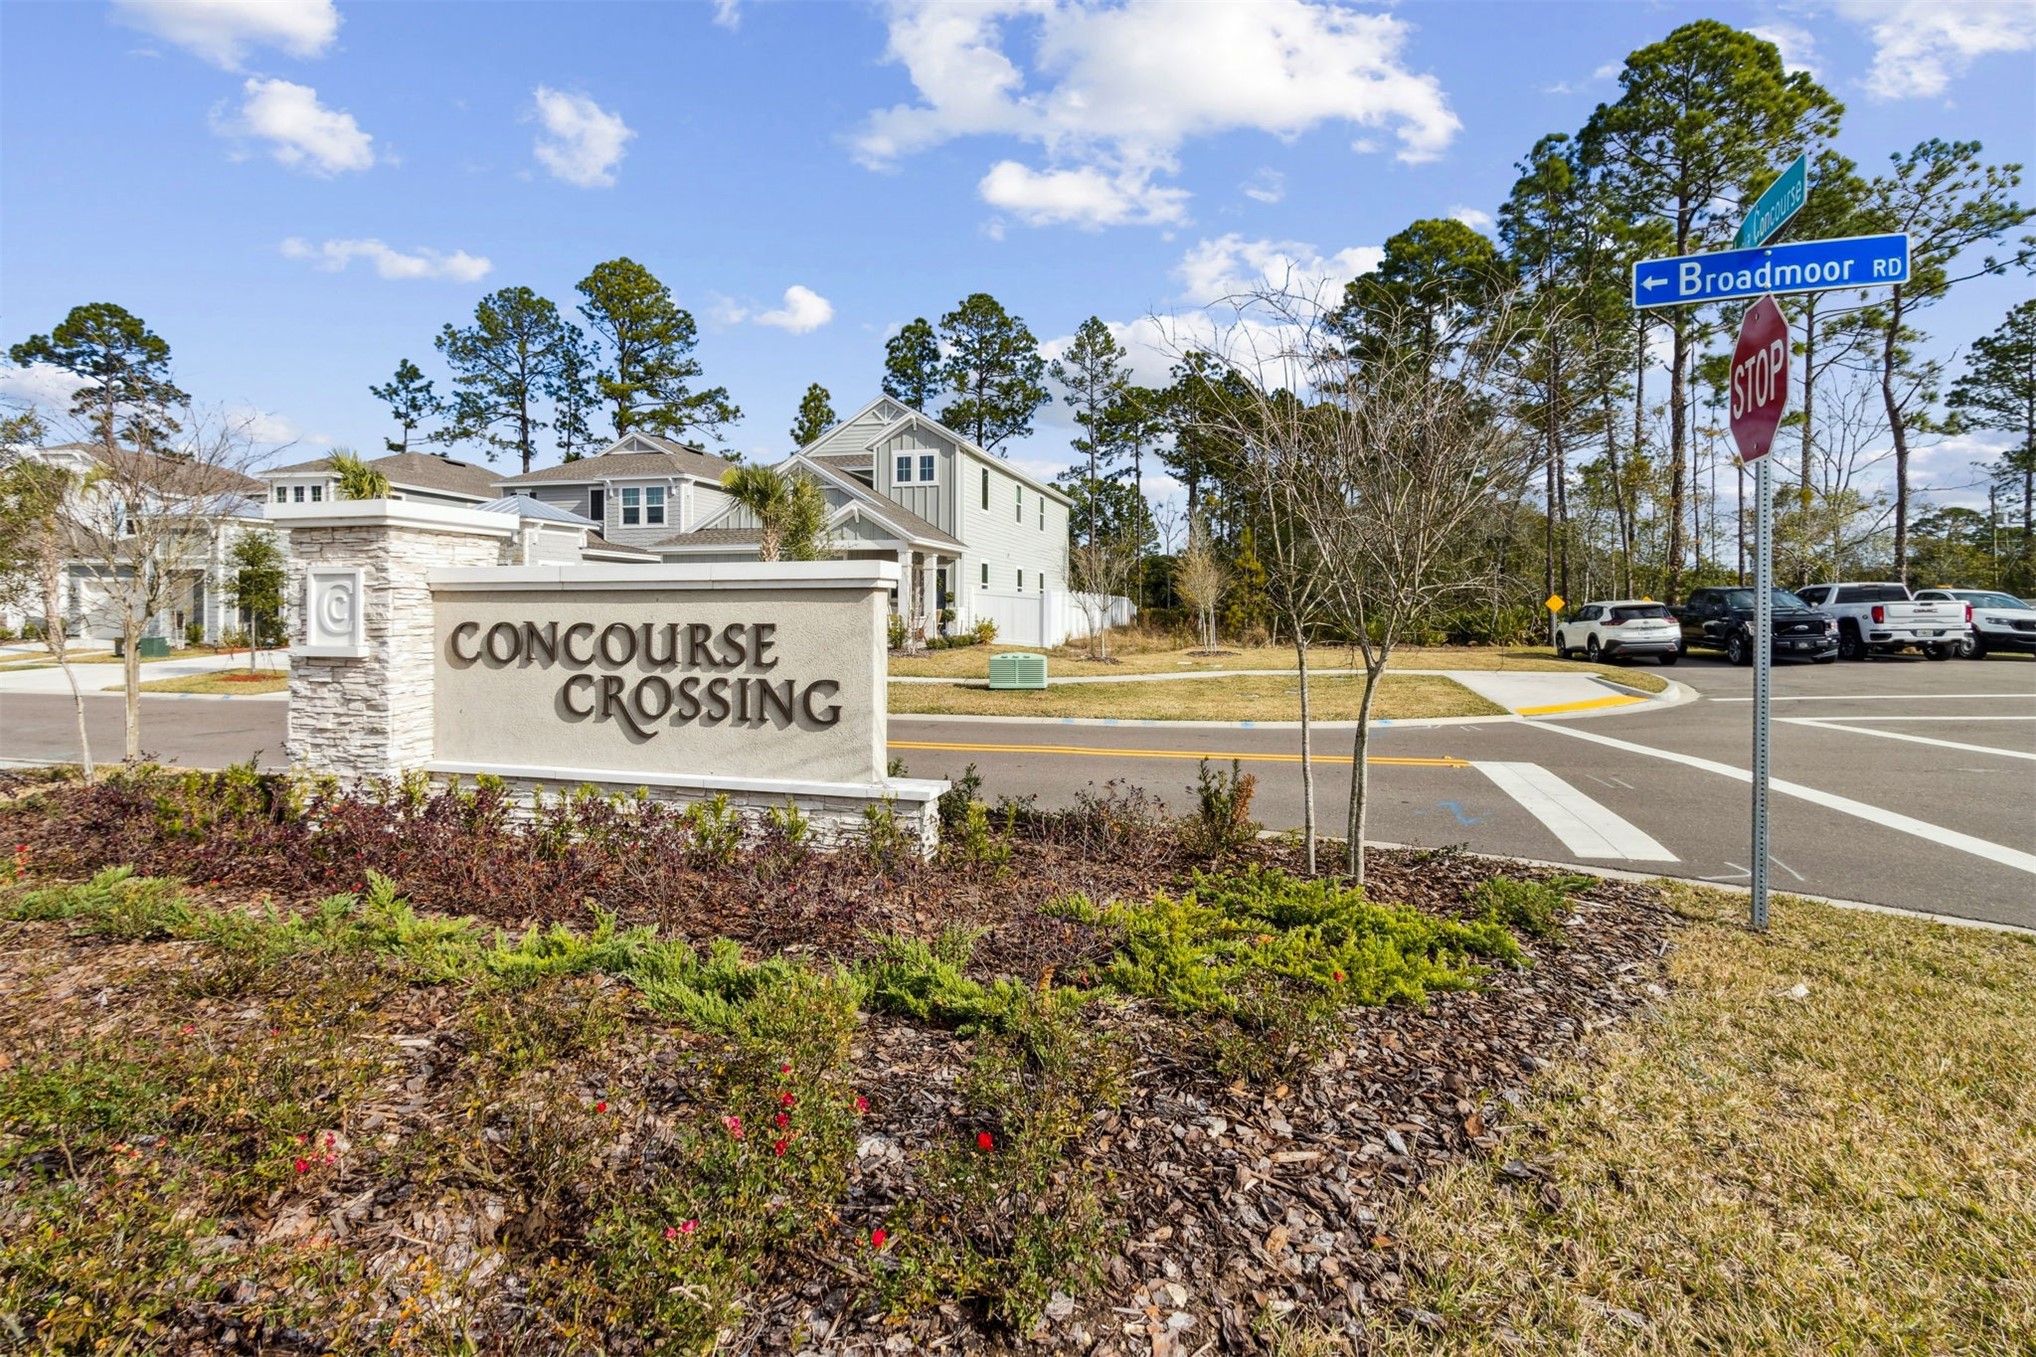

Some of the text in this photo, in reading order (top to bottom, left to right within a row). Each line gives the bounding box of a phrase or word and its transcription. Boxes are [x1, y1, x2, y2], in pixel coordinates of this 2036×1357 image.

[1753, 180, 1802, 243] Concourse
[1678, 257, 1902, 296] Broadmoor RD
[1733, 339, 1784, 420] STOP
[450, 621, 779, 667] CONCOURSE
[562, 674, 843, 739] CROSSING
